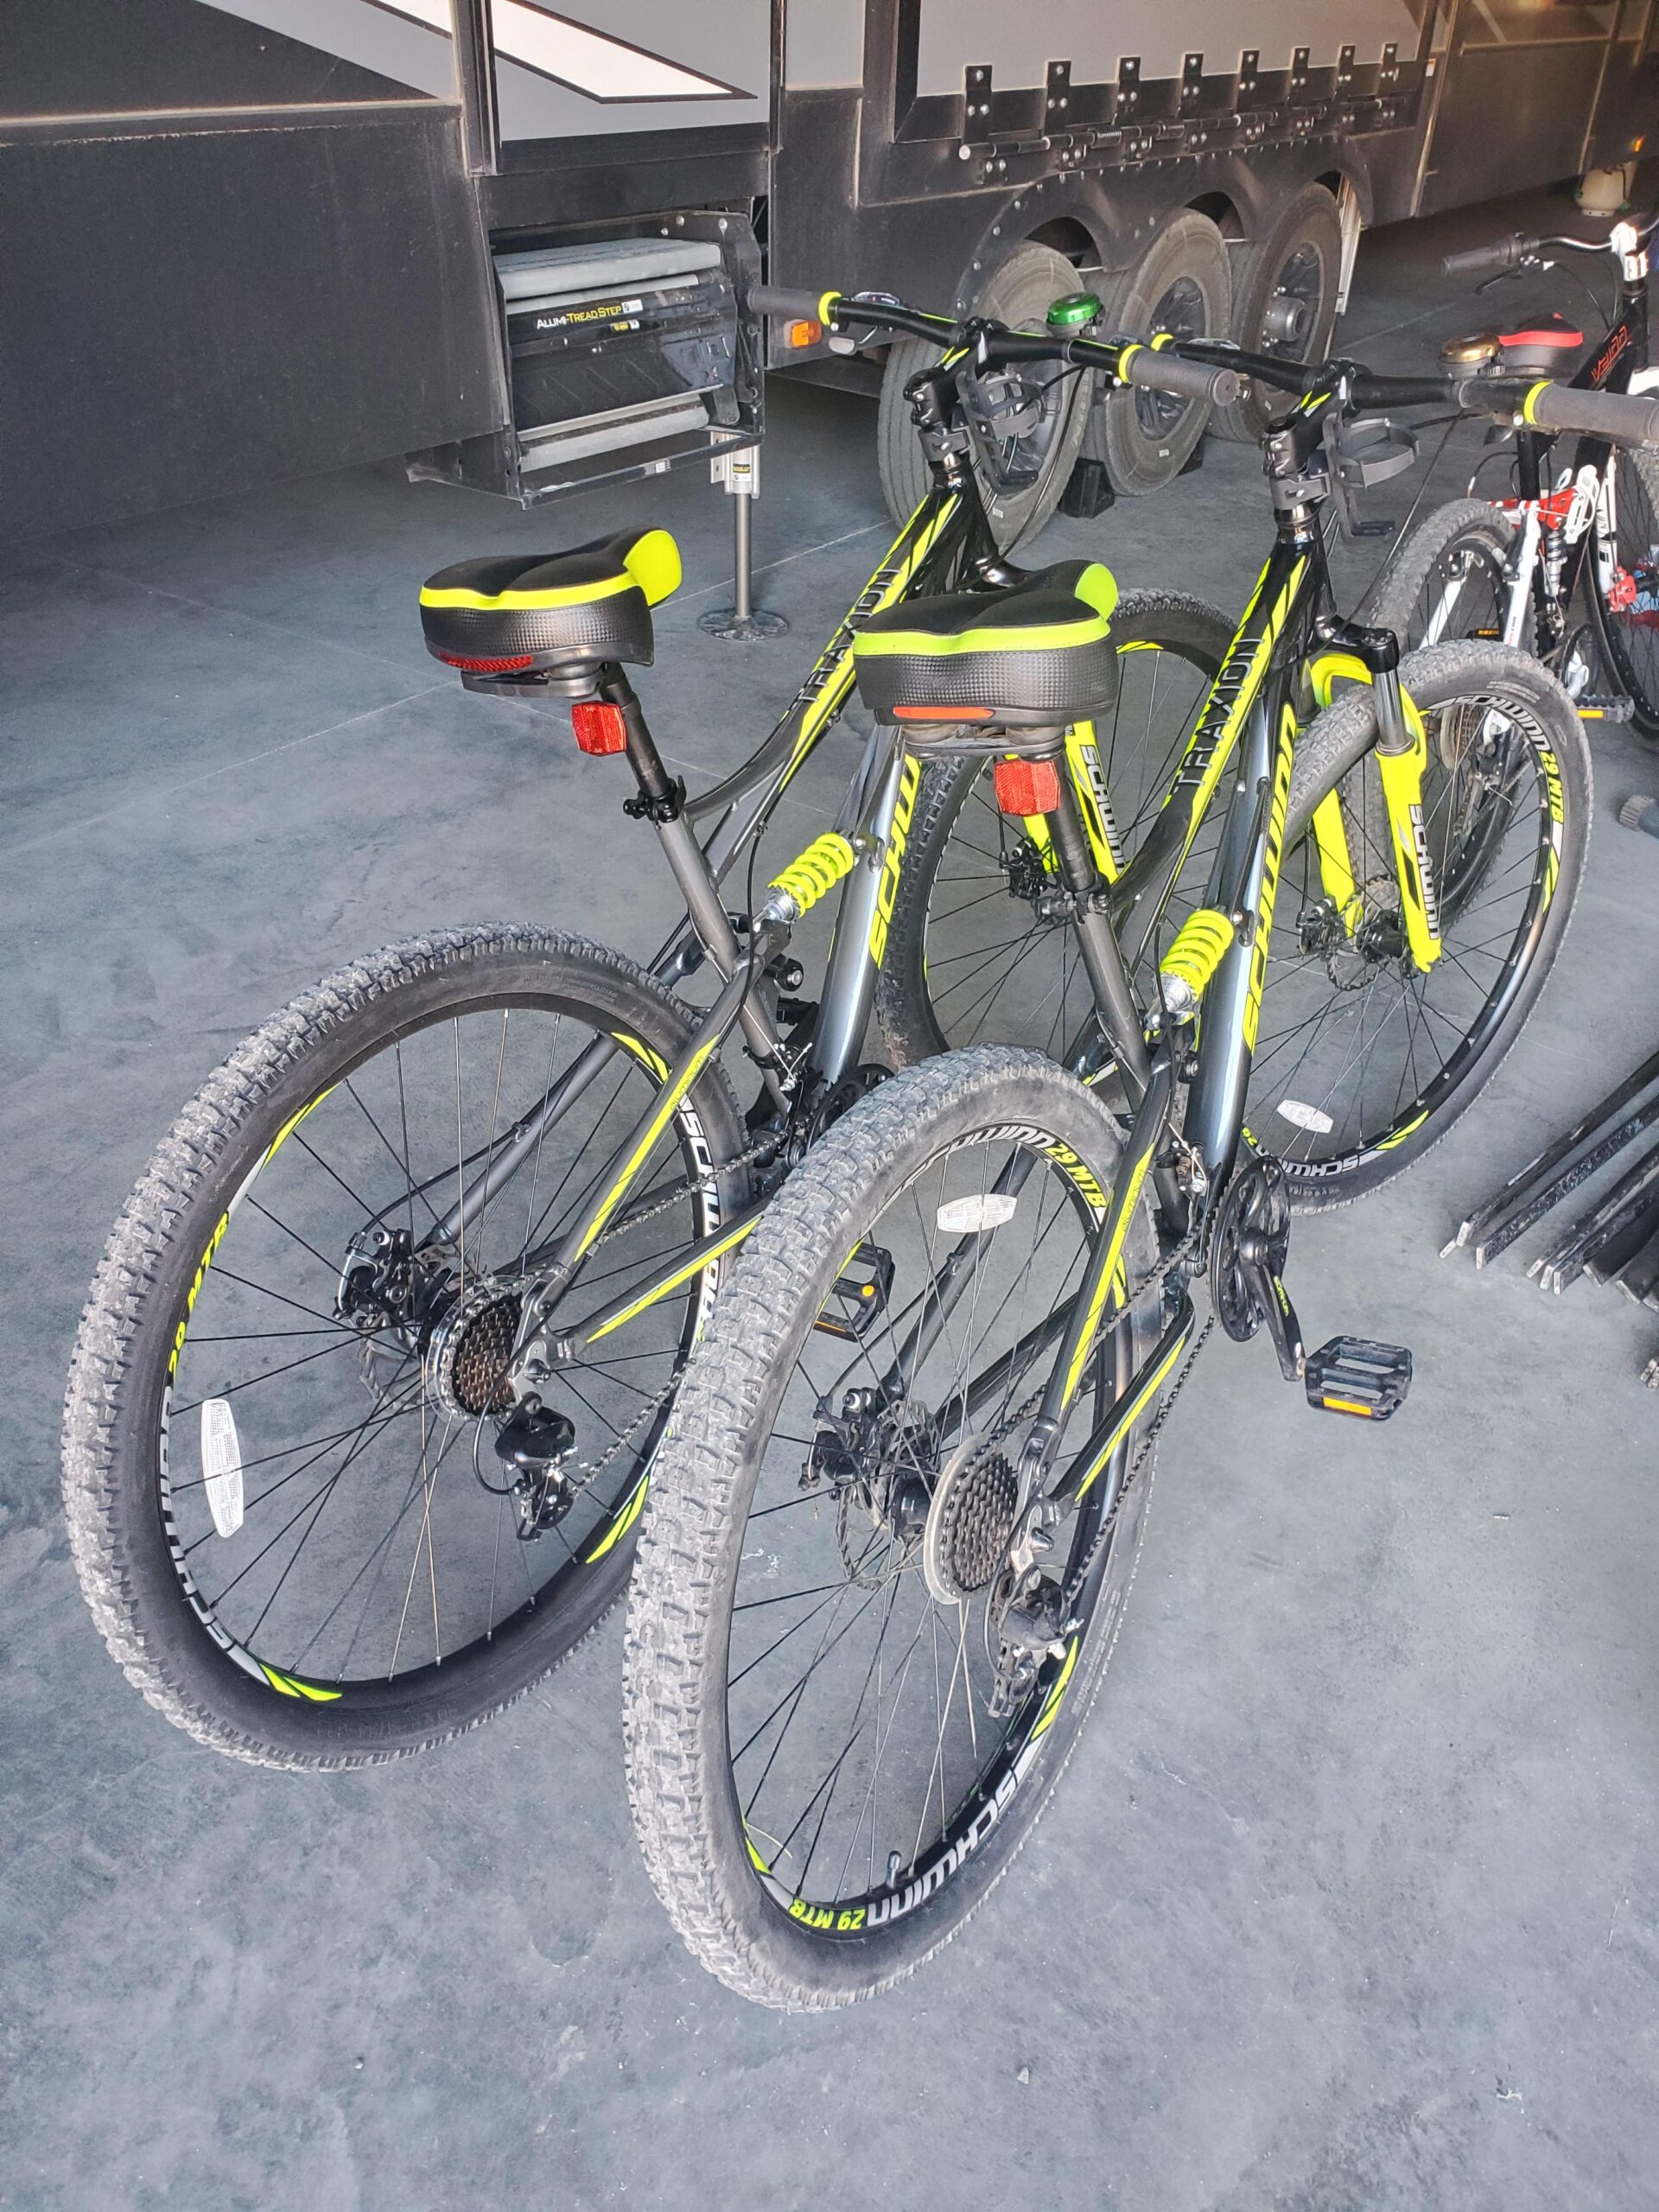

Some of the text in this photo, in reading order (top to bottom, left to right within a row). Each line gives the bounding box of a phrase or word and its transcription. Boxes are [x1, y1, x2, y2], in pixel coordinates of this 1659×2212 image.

[598, 305, 622, 318] STEP
[1170, 638, 1265, 795] TRAXION
[1454, 695, 1564, 824] SCHWINN 29 MTB
[868, 753, 923, 971] SCHW
[1242, 702, 1298, 1057] SCHWINN
[1408, 804, 1440, 941] SCHWINN
[1044, 1142, 1078, 1165] 29
[1067, 1164, 1108, 1209] MTB
[789, 1767, 1018, 1930] SCHWINN 29 MTB
